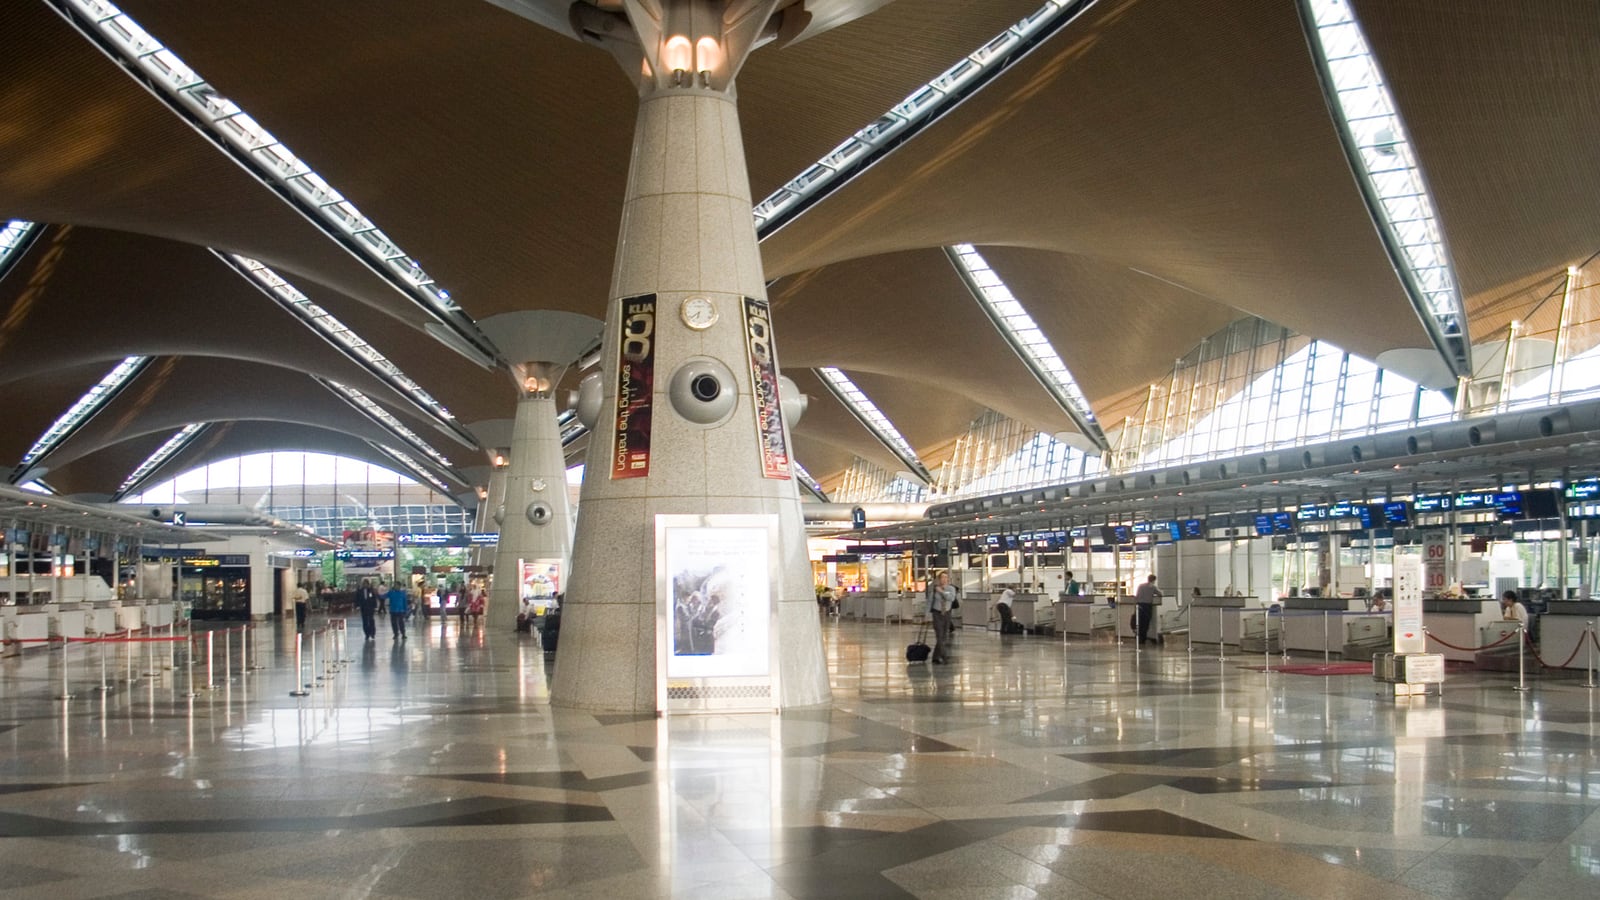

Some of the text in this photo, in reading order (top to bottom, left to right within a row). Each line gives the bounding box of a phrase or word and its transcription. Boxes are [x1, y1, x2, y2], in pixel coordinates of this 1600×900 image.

[628, 303, 655, 314] KLIA
[749, 304, 768, 320] KLIA
[617, 364, 631, 471] serving the nation
[754, 364, 774, 470] serving the nation
[173, 513, 184, 525] K
[856, 512, 865, 523] L
[1428, 544, 1444, 558] 60
[1430, 573, 1444, 587] 10
